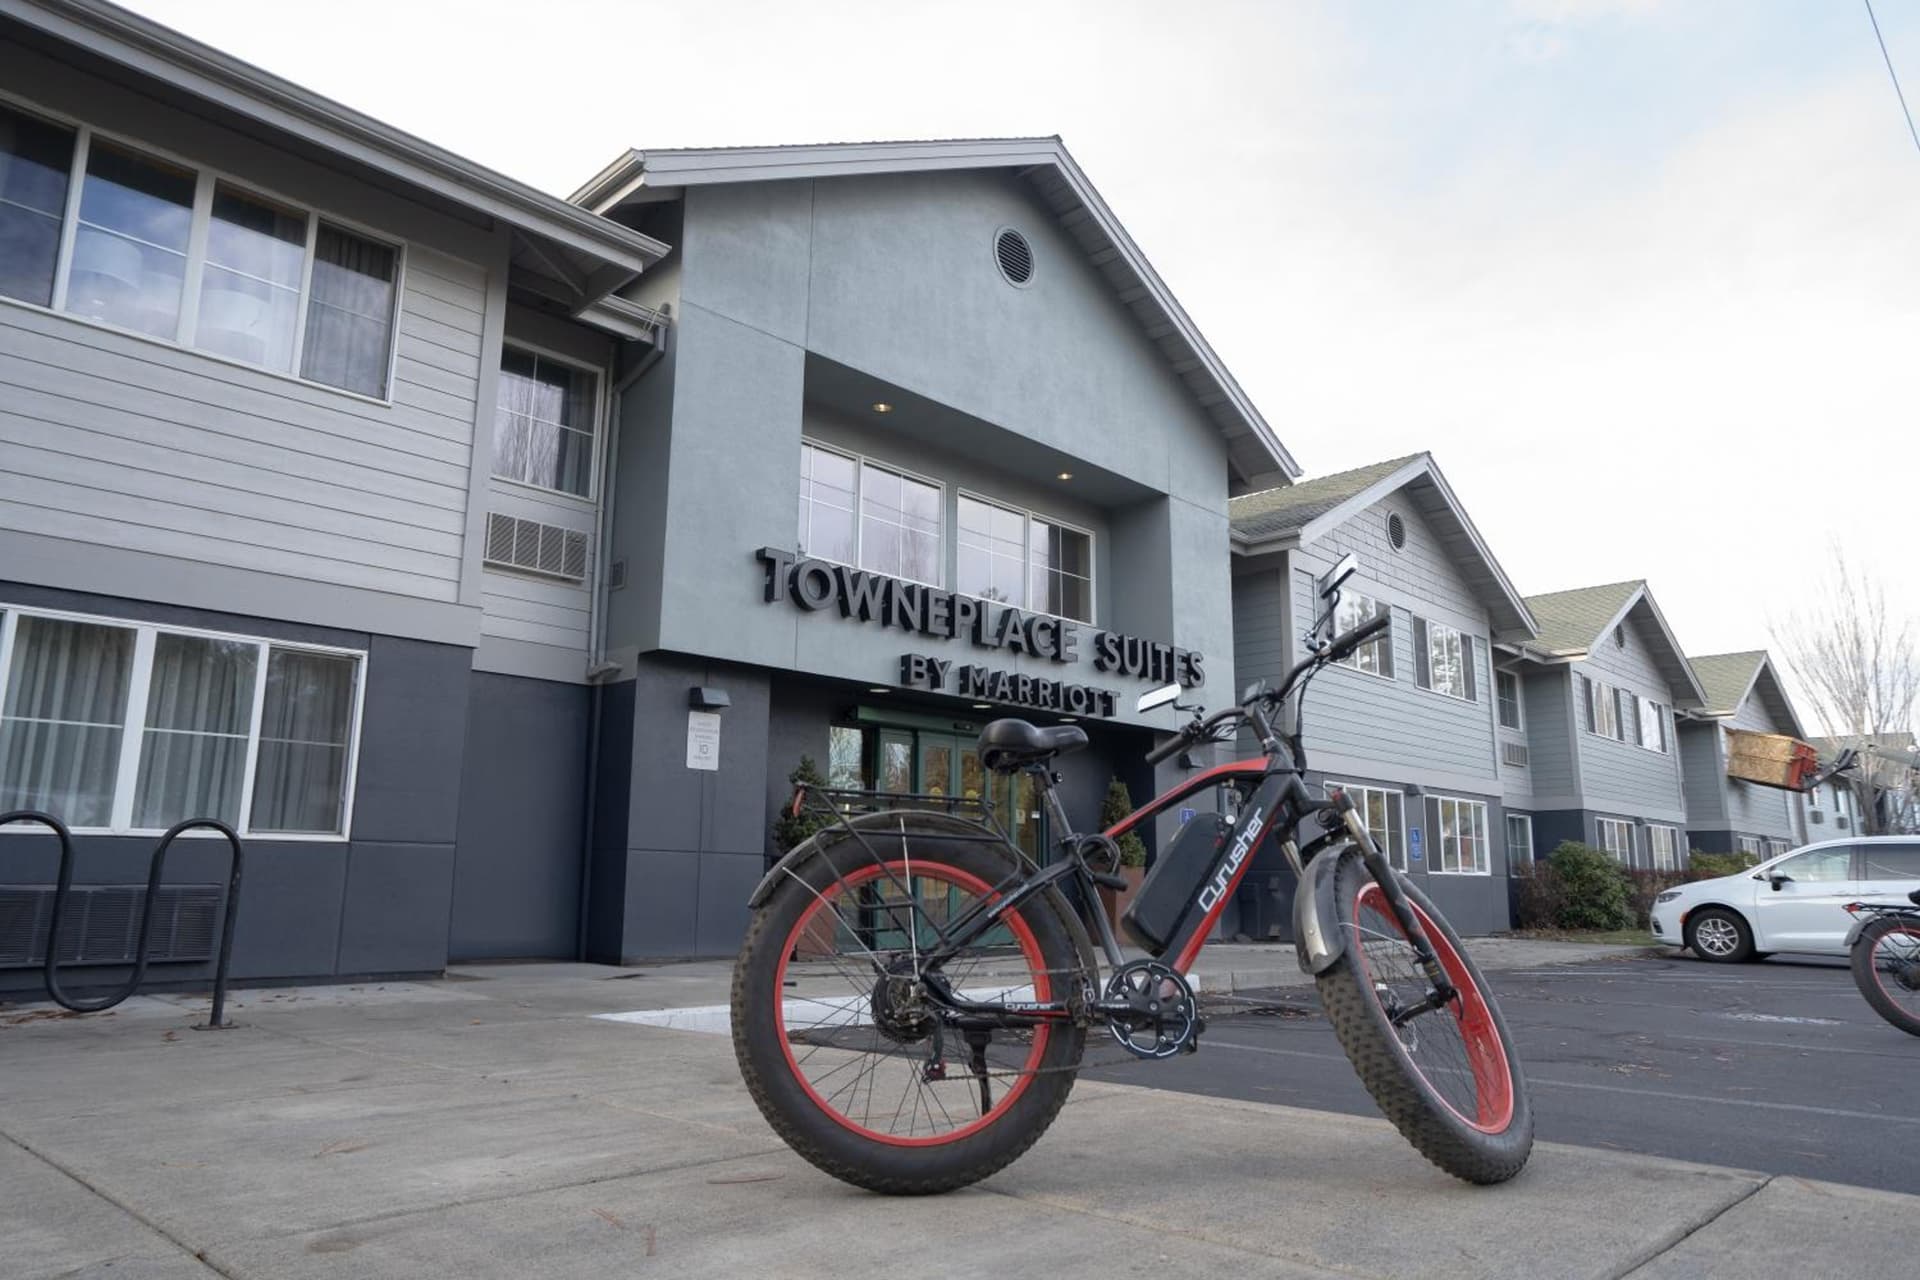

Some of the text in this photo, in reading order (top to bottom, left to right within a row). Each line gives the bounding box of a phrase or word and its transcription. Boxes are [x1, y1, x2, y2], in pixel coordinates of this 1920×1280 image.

[756, 546, 1206, 688] TOWNEPLACE SUITES
[901, 653, 1121, 718] BY MARRIOTT
[1198, 807, 1263, 913] Cyrusher
